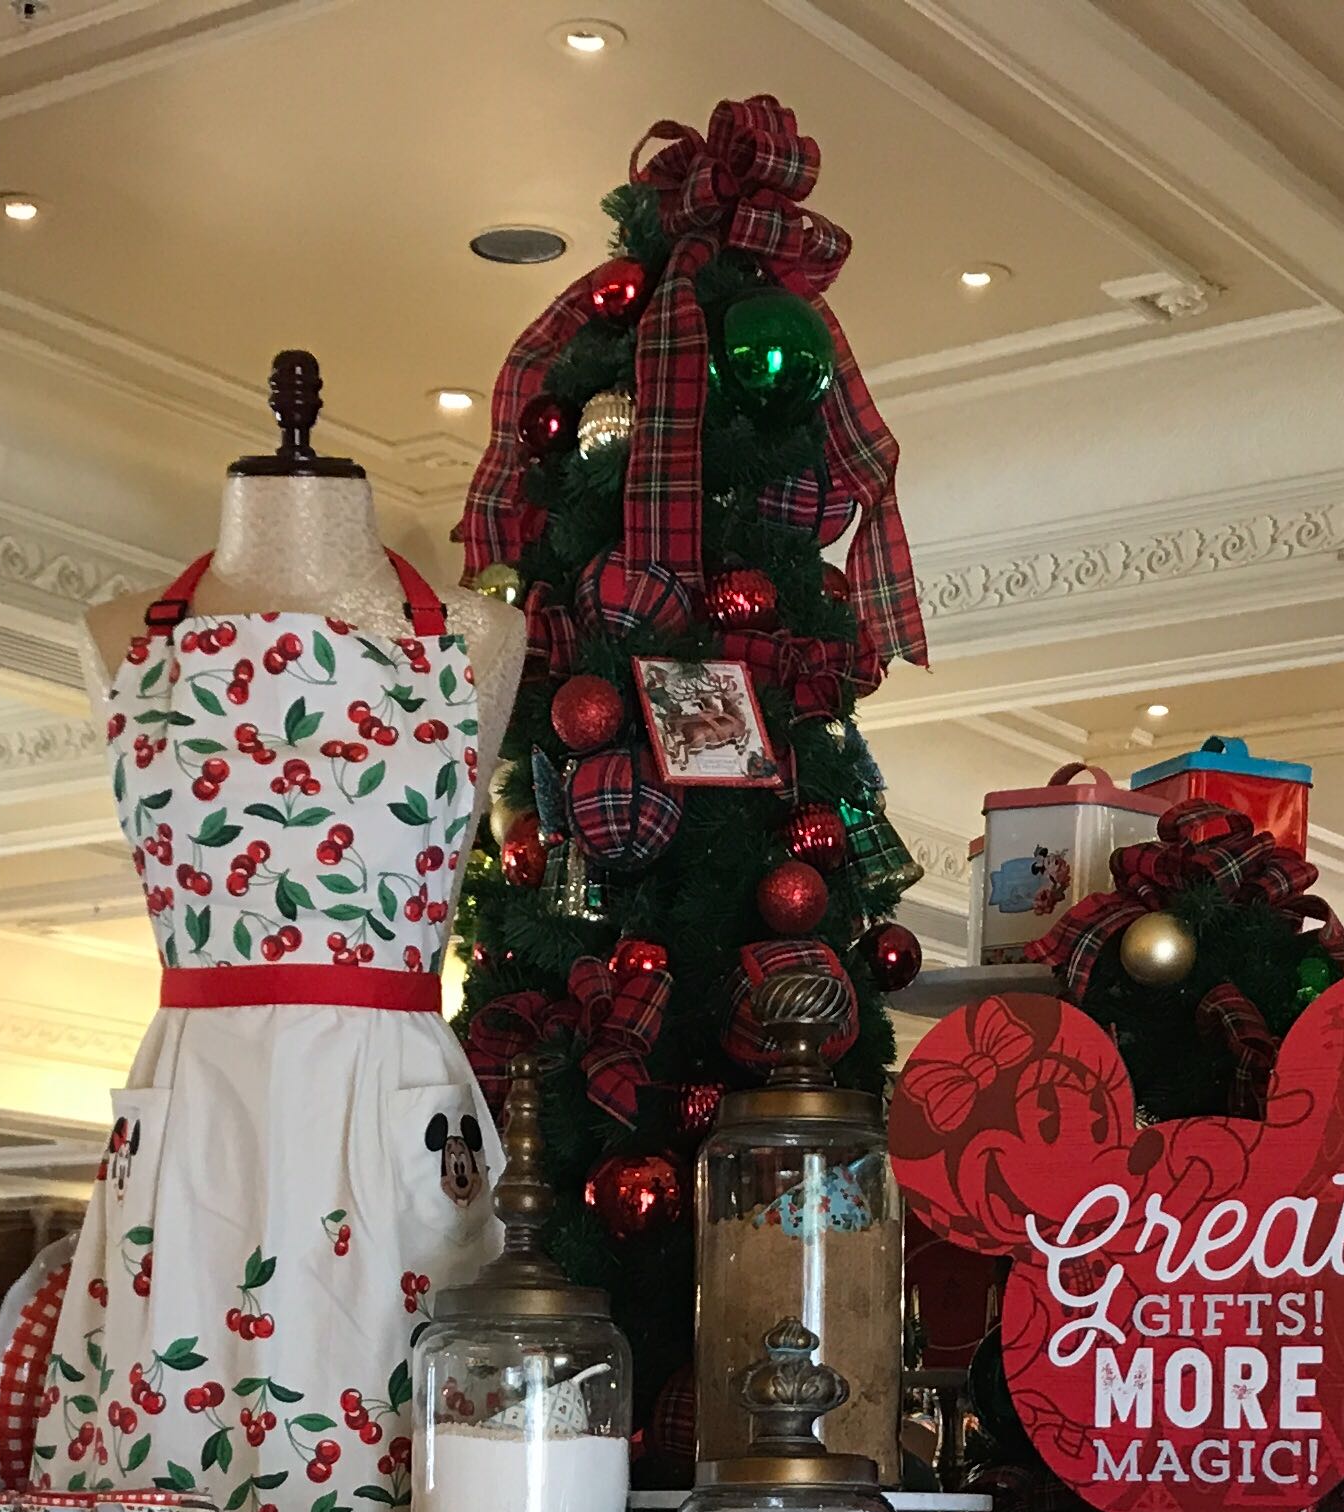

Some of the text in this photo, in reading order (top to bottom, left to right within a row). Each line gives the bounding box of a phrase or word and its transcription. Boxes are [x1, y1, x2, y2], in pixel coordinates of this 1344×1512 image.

[1132, 1292, 1325, 1338] GIFTS!
[1094, 1346, 1323, 1431] MORE
[1092, 1438, 1320, 1485] MAGIC!
